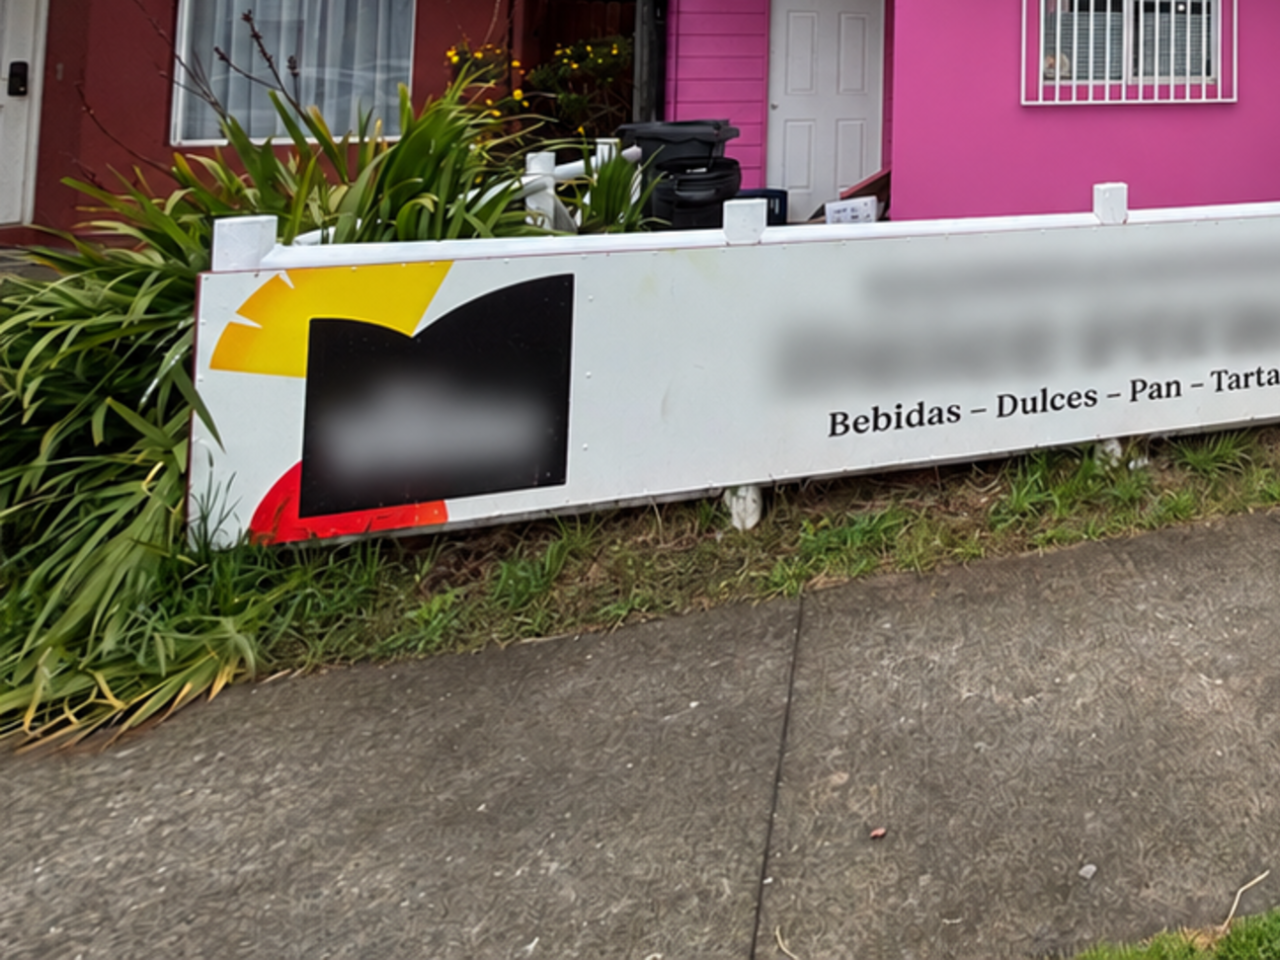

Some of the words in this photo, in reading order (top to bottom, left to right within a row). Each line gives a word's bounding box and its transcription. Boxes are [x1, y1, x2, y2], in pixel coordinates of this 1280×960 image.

[828, 401, 961, 438] Bebidas
[997, 387, 1098, 418] Dulces
[1130, 379, 1182, 402] Pan
